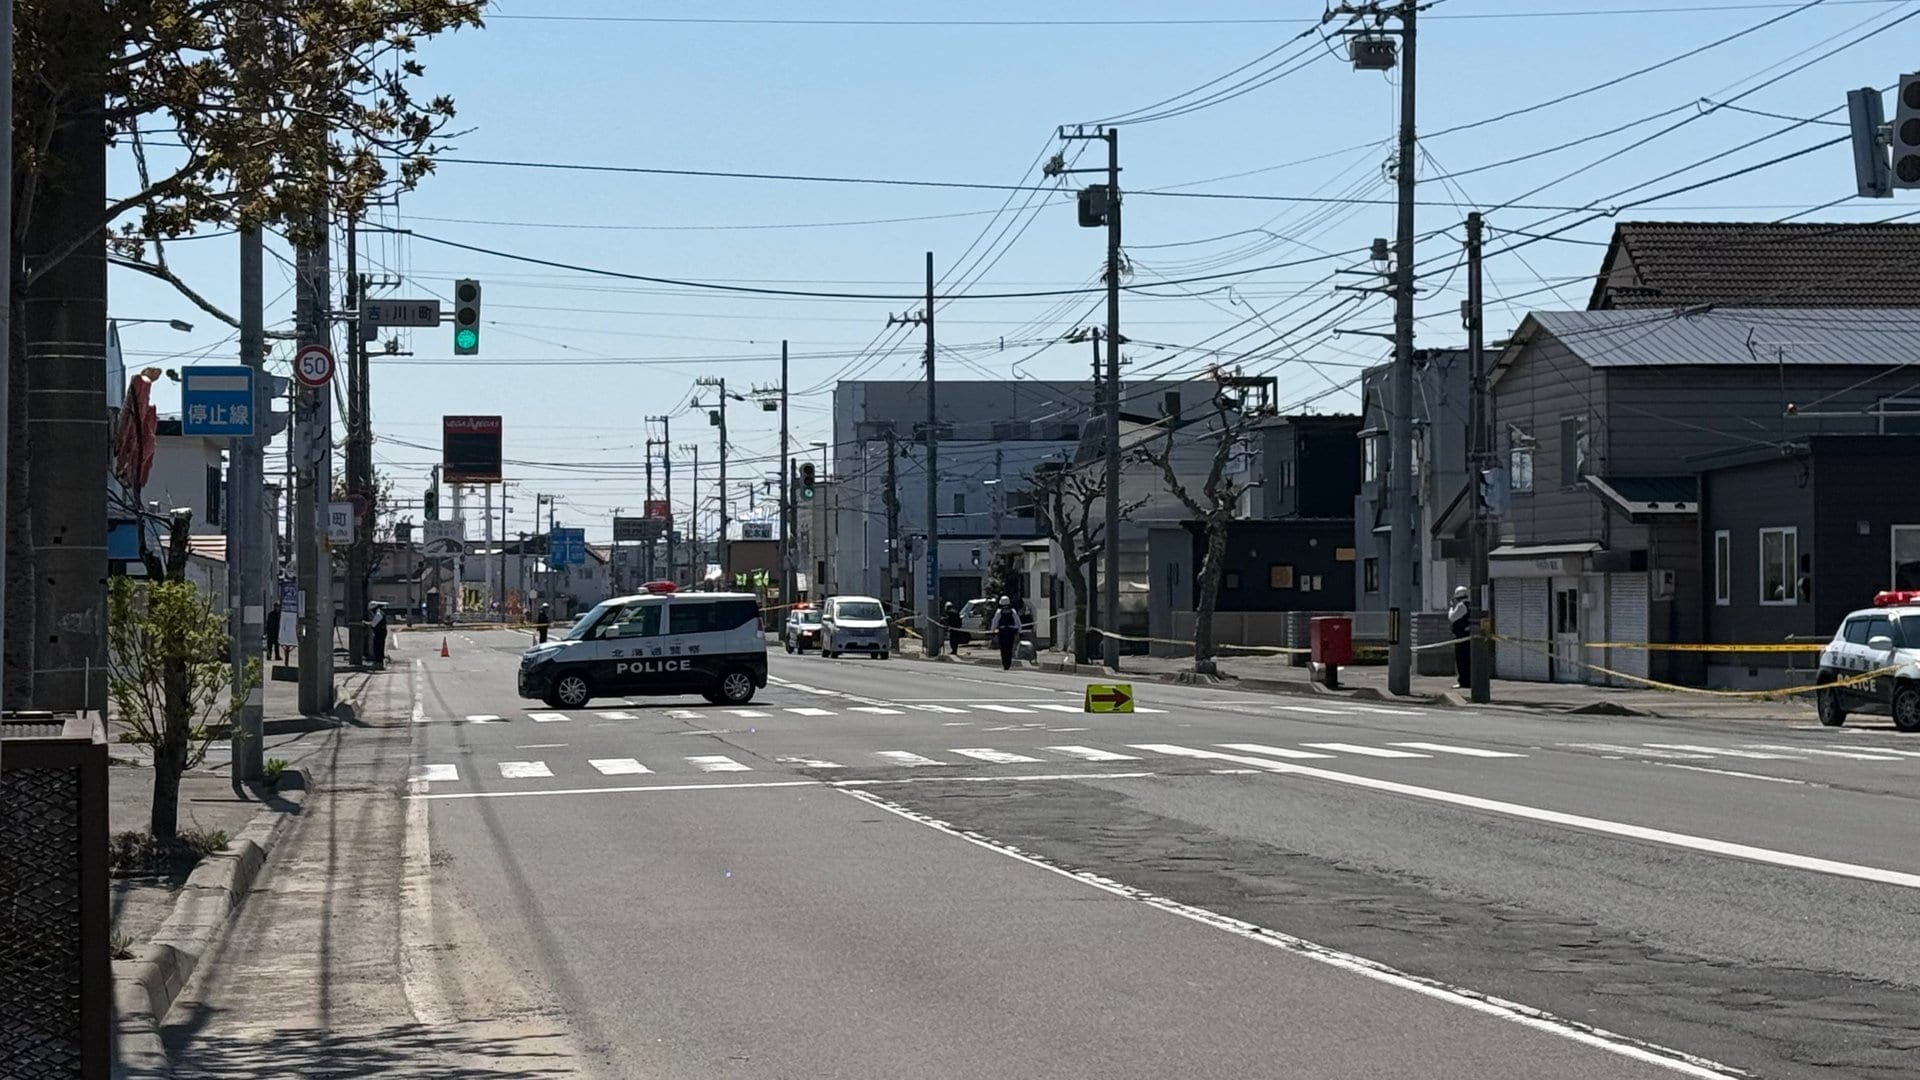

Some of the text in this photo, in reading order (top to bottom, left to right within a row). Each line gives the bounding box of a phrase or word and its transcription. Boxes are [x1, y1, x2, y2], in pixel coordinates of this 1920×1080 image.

[367, 304, 432, 321] 吉川町
[303, 358, 326, 375] 50
[188, 403, 249, 425] 停止線
[612, 645, 700, 657] 北海道警察
[617, 659, 691, 674] POLICE
